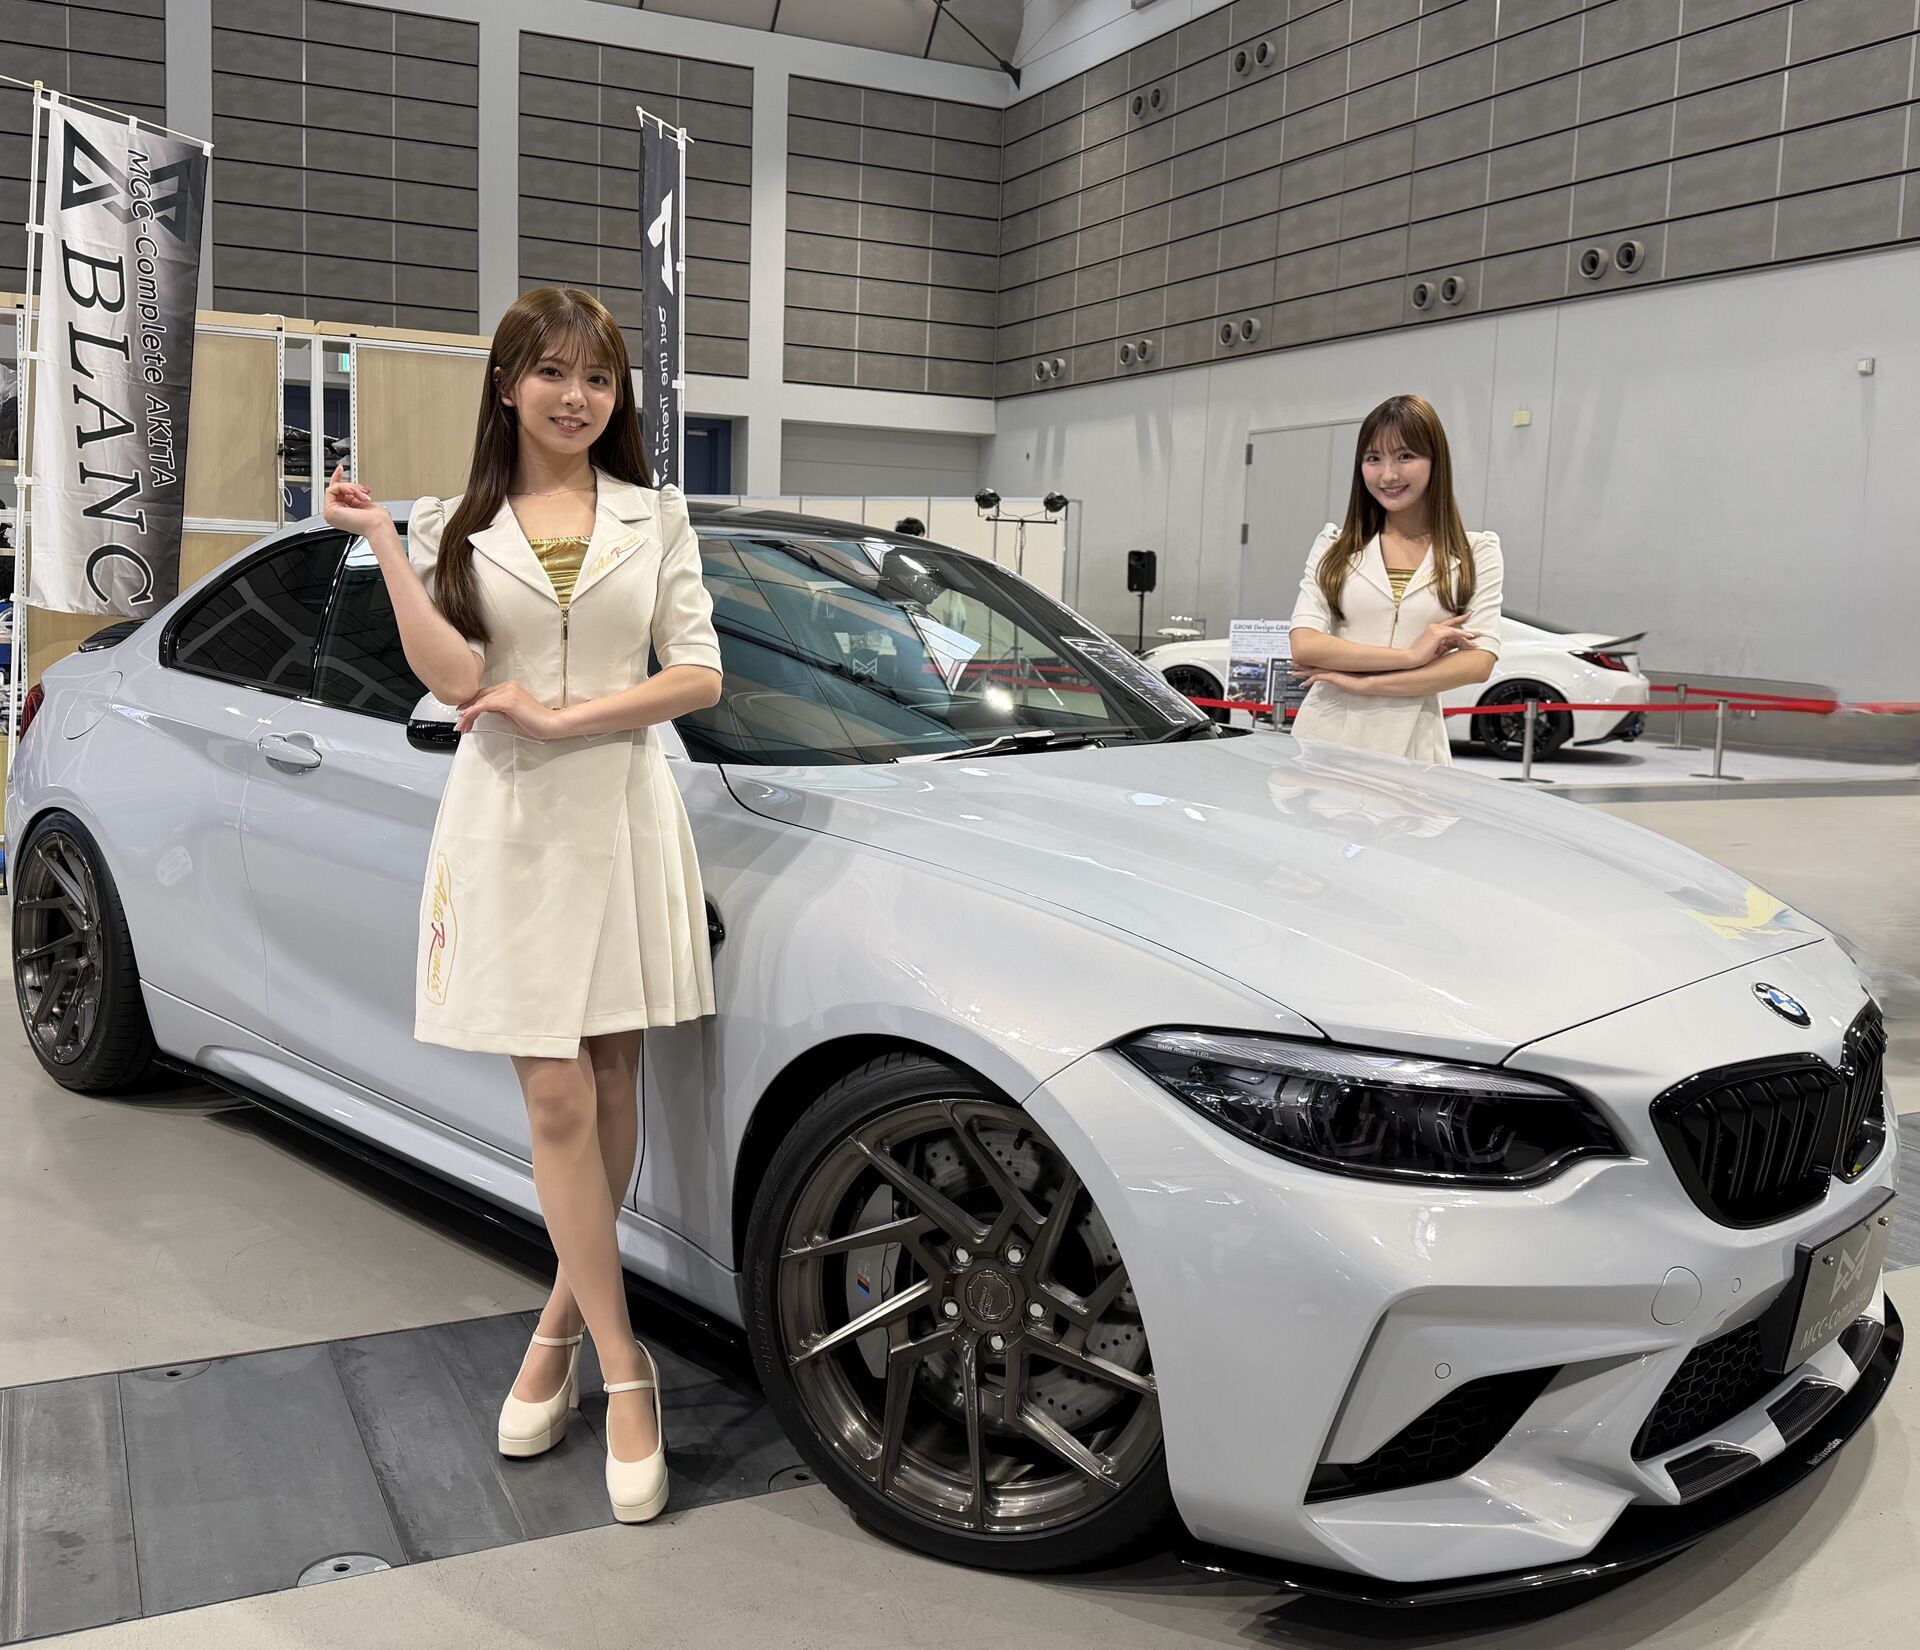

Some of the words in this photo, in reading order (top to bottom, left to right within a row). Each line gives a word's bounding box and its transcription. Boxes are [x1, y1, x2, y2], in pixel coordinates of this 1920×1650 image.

[61, 239, 154, 606] BLANC
[127, 148, 164, 384] MCC-Complete
[146, 394, 176, 488] AKITA
